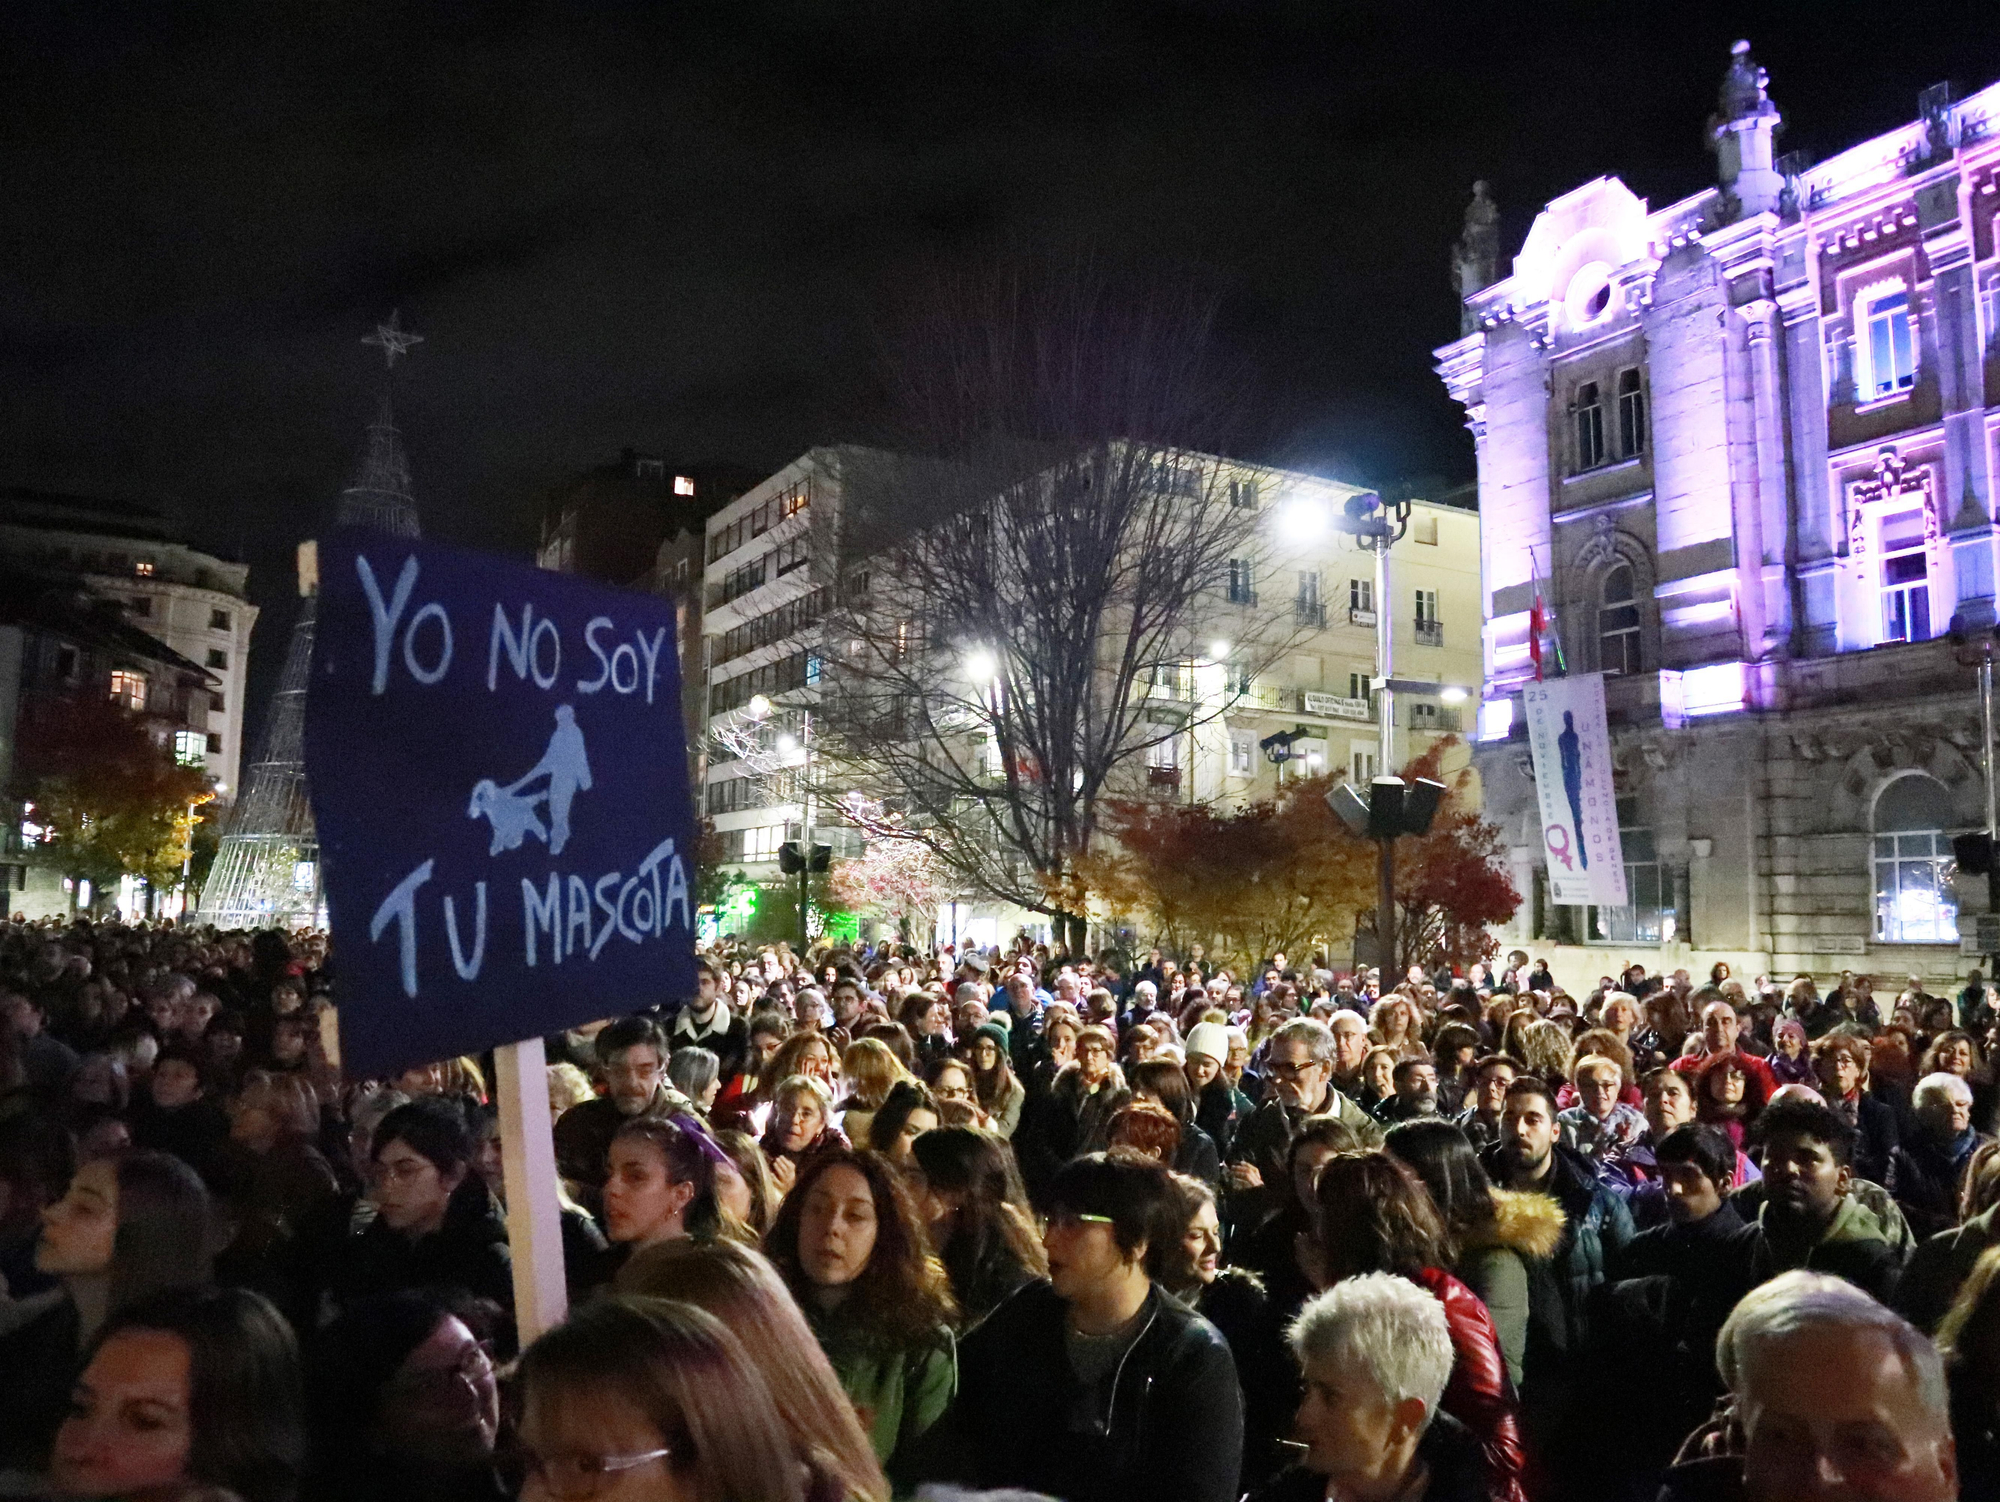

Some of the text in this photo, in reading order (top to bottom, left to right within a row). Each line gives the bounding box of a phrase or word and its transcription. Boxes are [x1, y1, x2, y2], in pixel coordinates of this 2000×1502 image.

[356, 553, 666, 704] YO NO SOY
[1528, 690, 1548, 702] 25
[1536, 708, 1543, 725] DE
[370, 837, 691, 1000] TU MASCOTA
